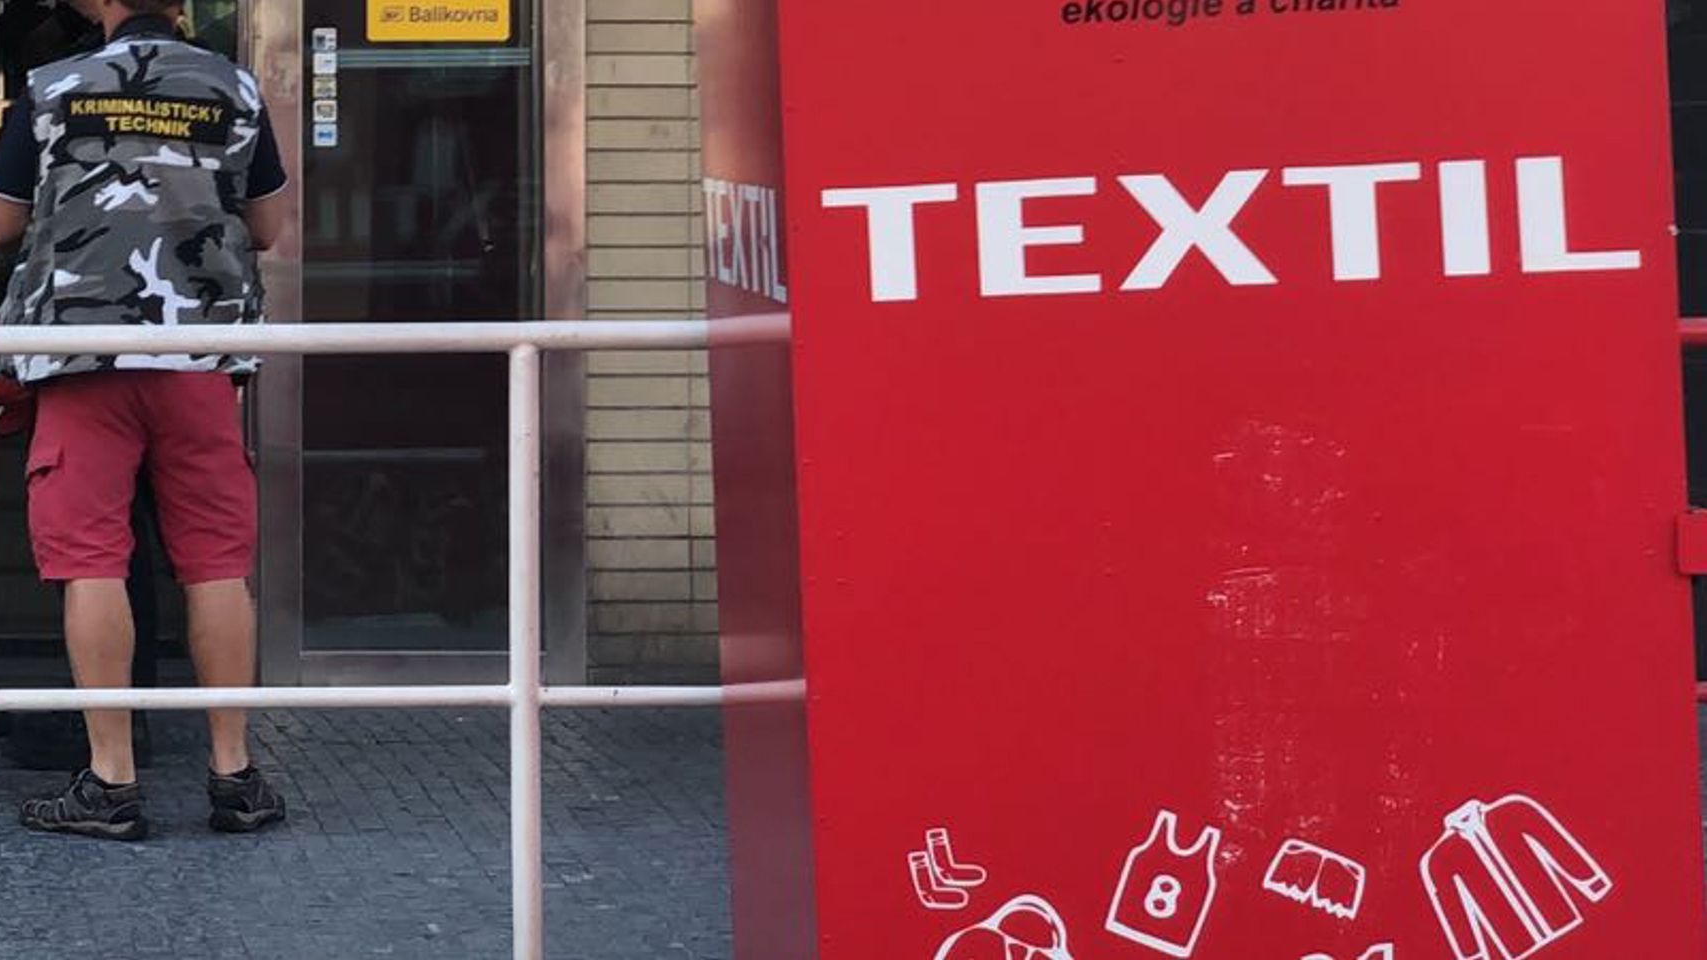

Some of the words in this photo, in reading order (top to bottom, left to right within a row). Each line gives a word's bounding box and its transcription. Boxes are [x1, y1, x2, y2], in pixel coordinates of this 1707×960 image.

[105, 117, 191, 137] TECHNIK
[702, 177, 787, 304] TEXTIL
[821, 156, 1641, 302] TEXTIL
